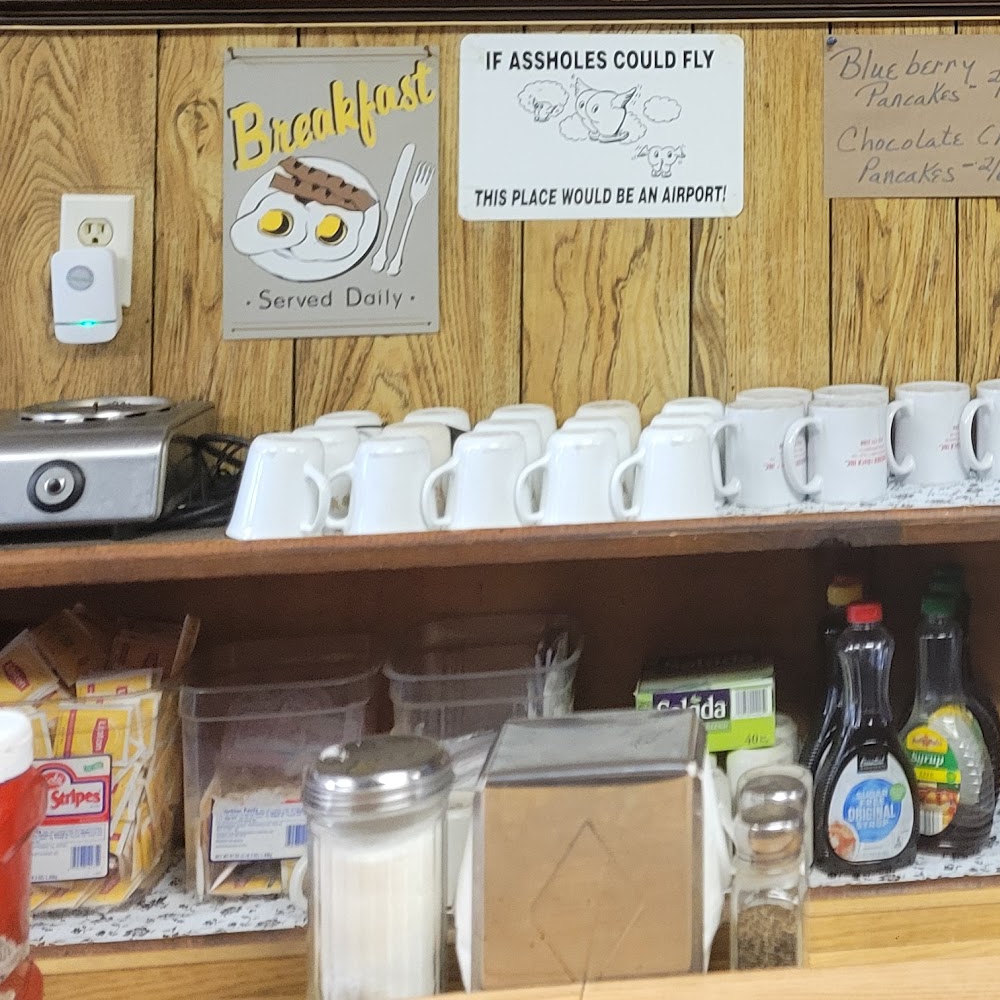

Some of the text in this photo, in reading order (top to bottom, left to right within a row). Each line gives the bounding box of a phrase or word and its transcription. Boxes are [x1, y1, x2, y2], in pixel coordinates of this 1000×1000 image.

[485, 51, 714, 71] IF ASSHOLES COULD FLY
[227, 60, 436, 172] Breakfast
[838, 125, 964, 152] Chocolate
[474, 185, 727, 207] THIS PLACE WOULD BE AN AIRPORT!
[259, 288, 403, 311] Served Daily
[848, 803, 896, 822] ORIGINAL
